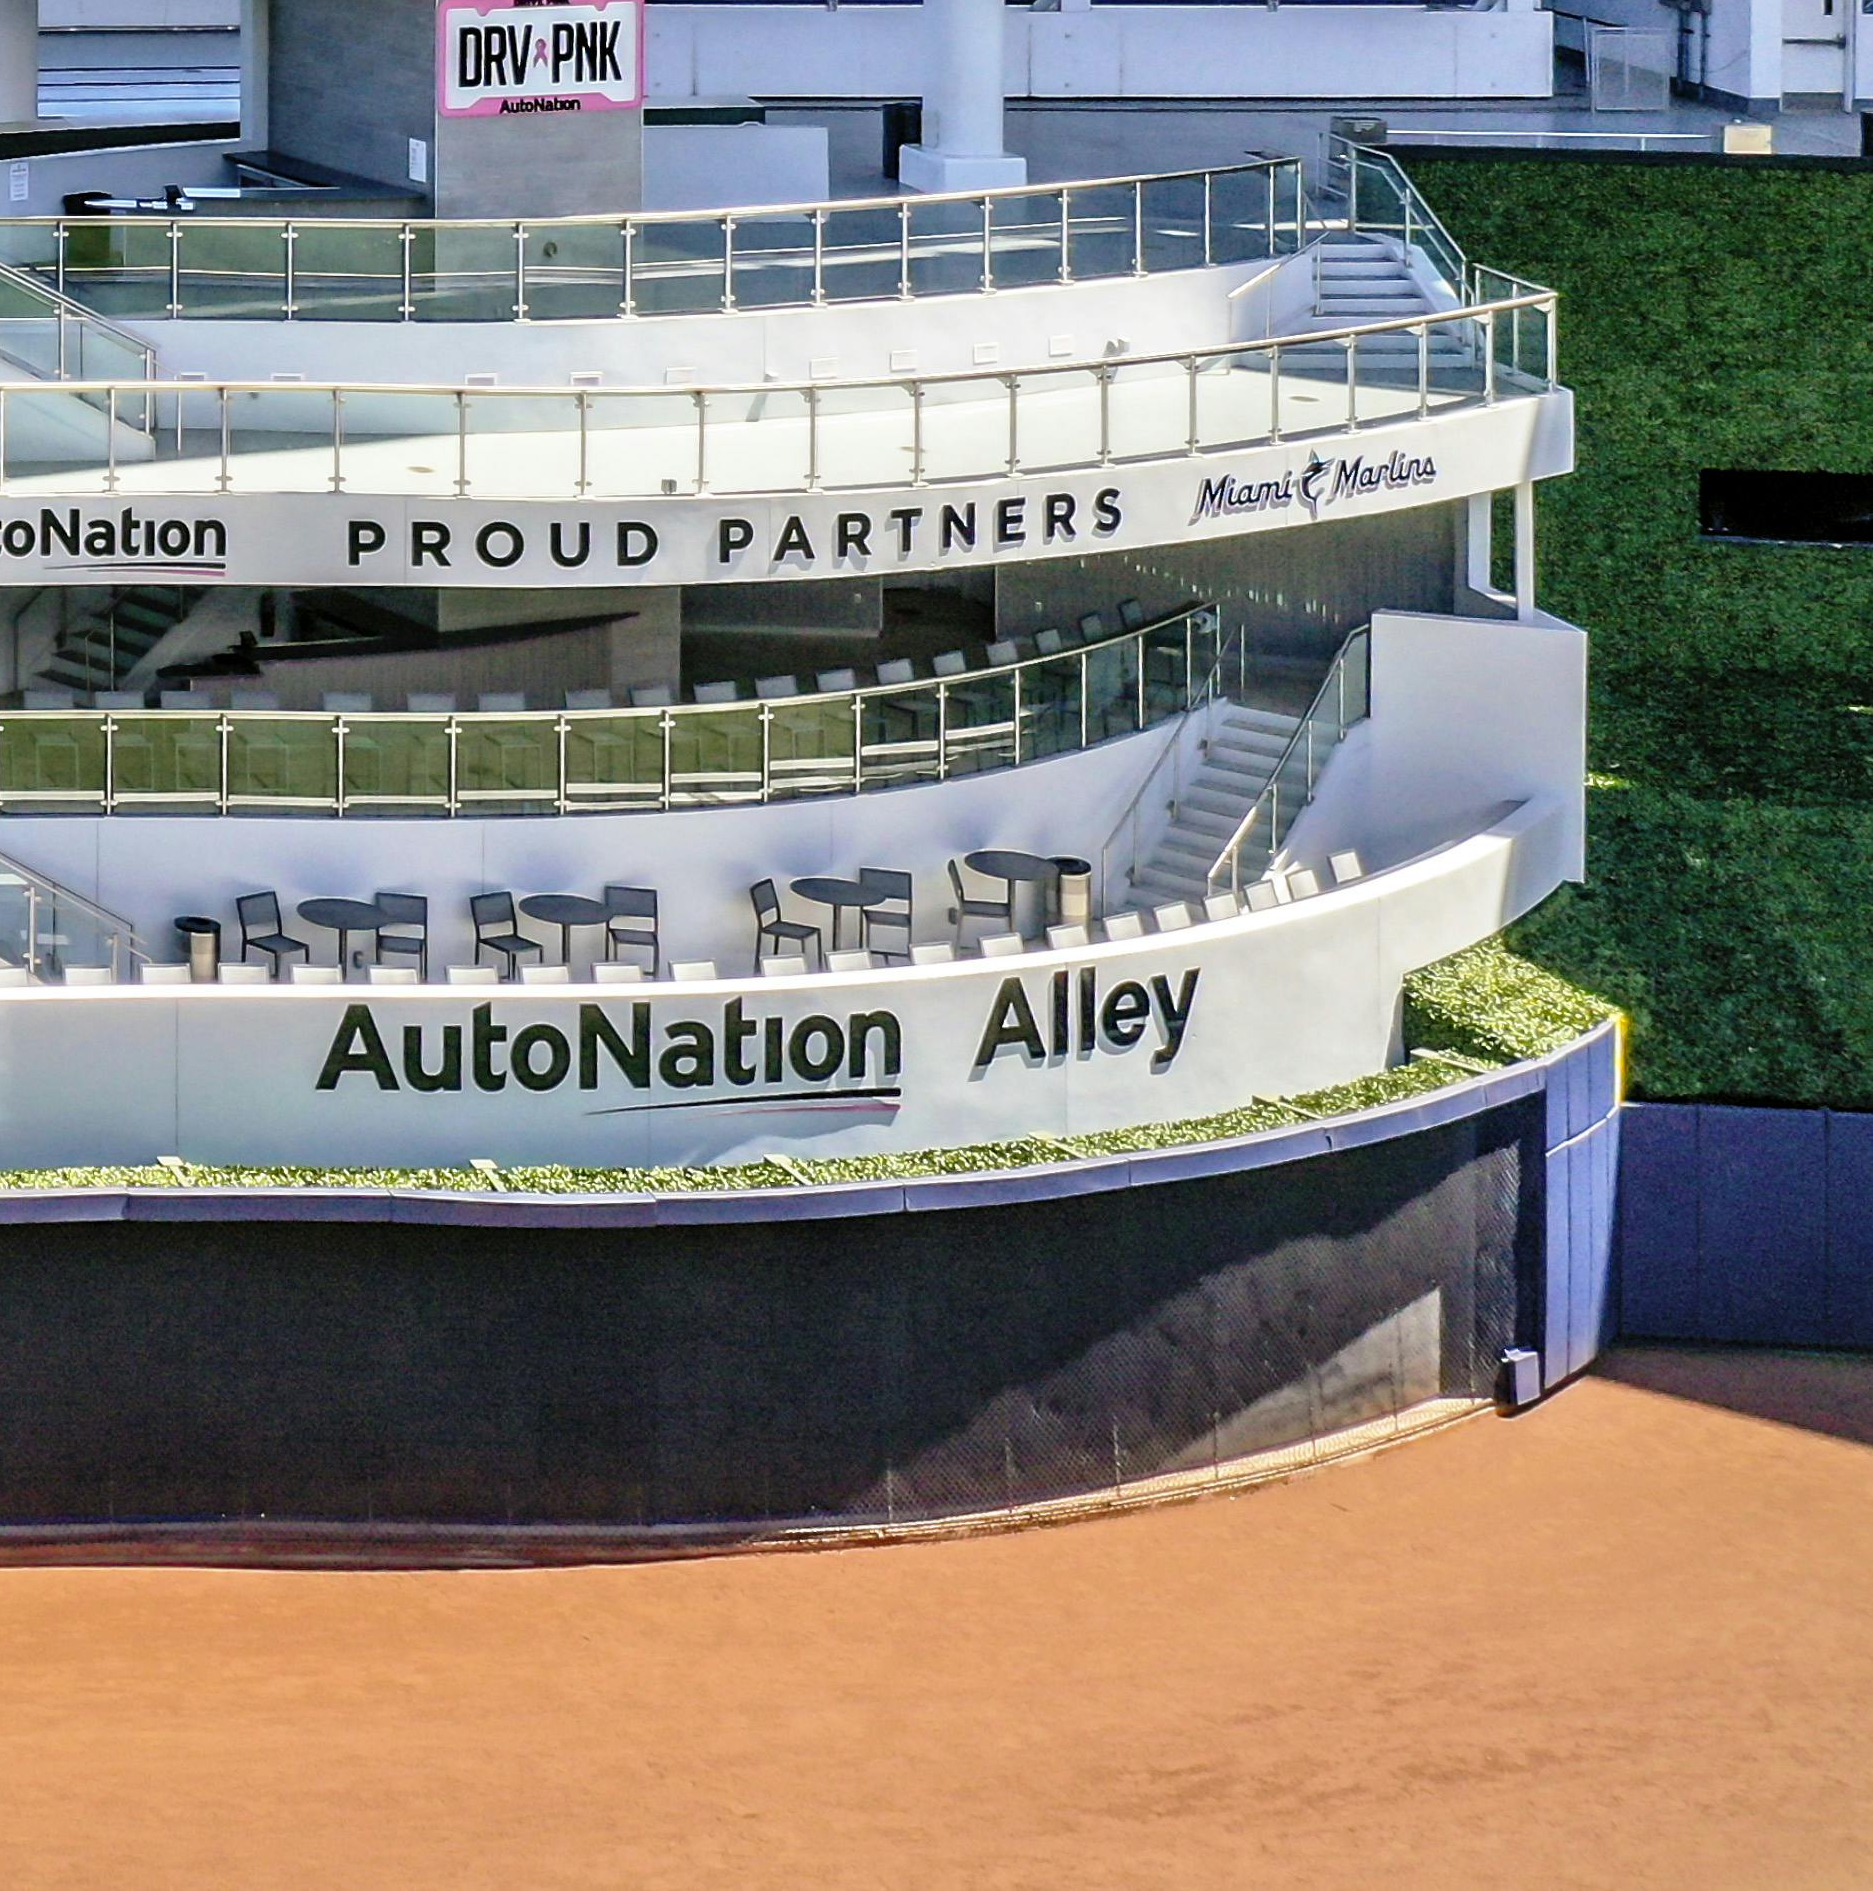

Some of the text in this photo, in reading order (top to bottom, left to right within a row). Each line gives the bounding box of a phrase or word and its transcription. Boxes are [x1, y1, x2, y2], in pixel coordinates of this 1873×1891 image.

[458, 21, 622, 88] DRV PNK
[500, 97, 581, 114] AutoNation
[348, 518, 658, 568] PROUD
[719, 488, 1122, 564] PARTNERS
[1196, 469, 1293, 518] Miami
[1333, 449, 1437, 496] Marlins
[316, 966, 1200, 1092] AutoNation Alley
